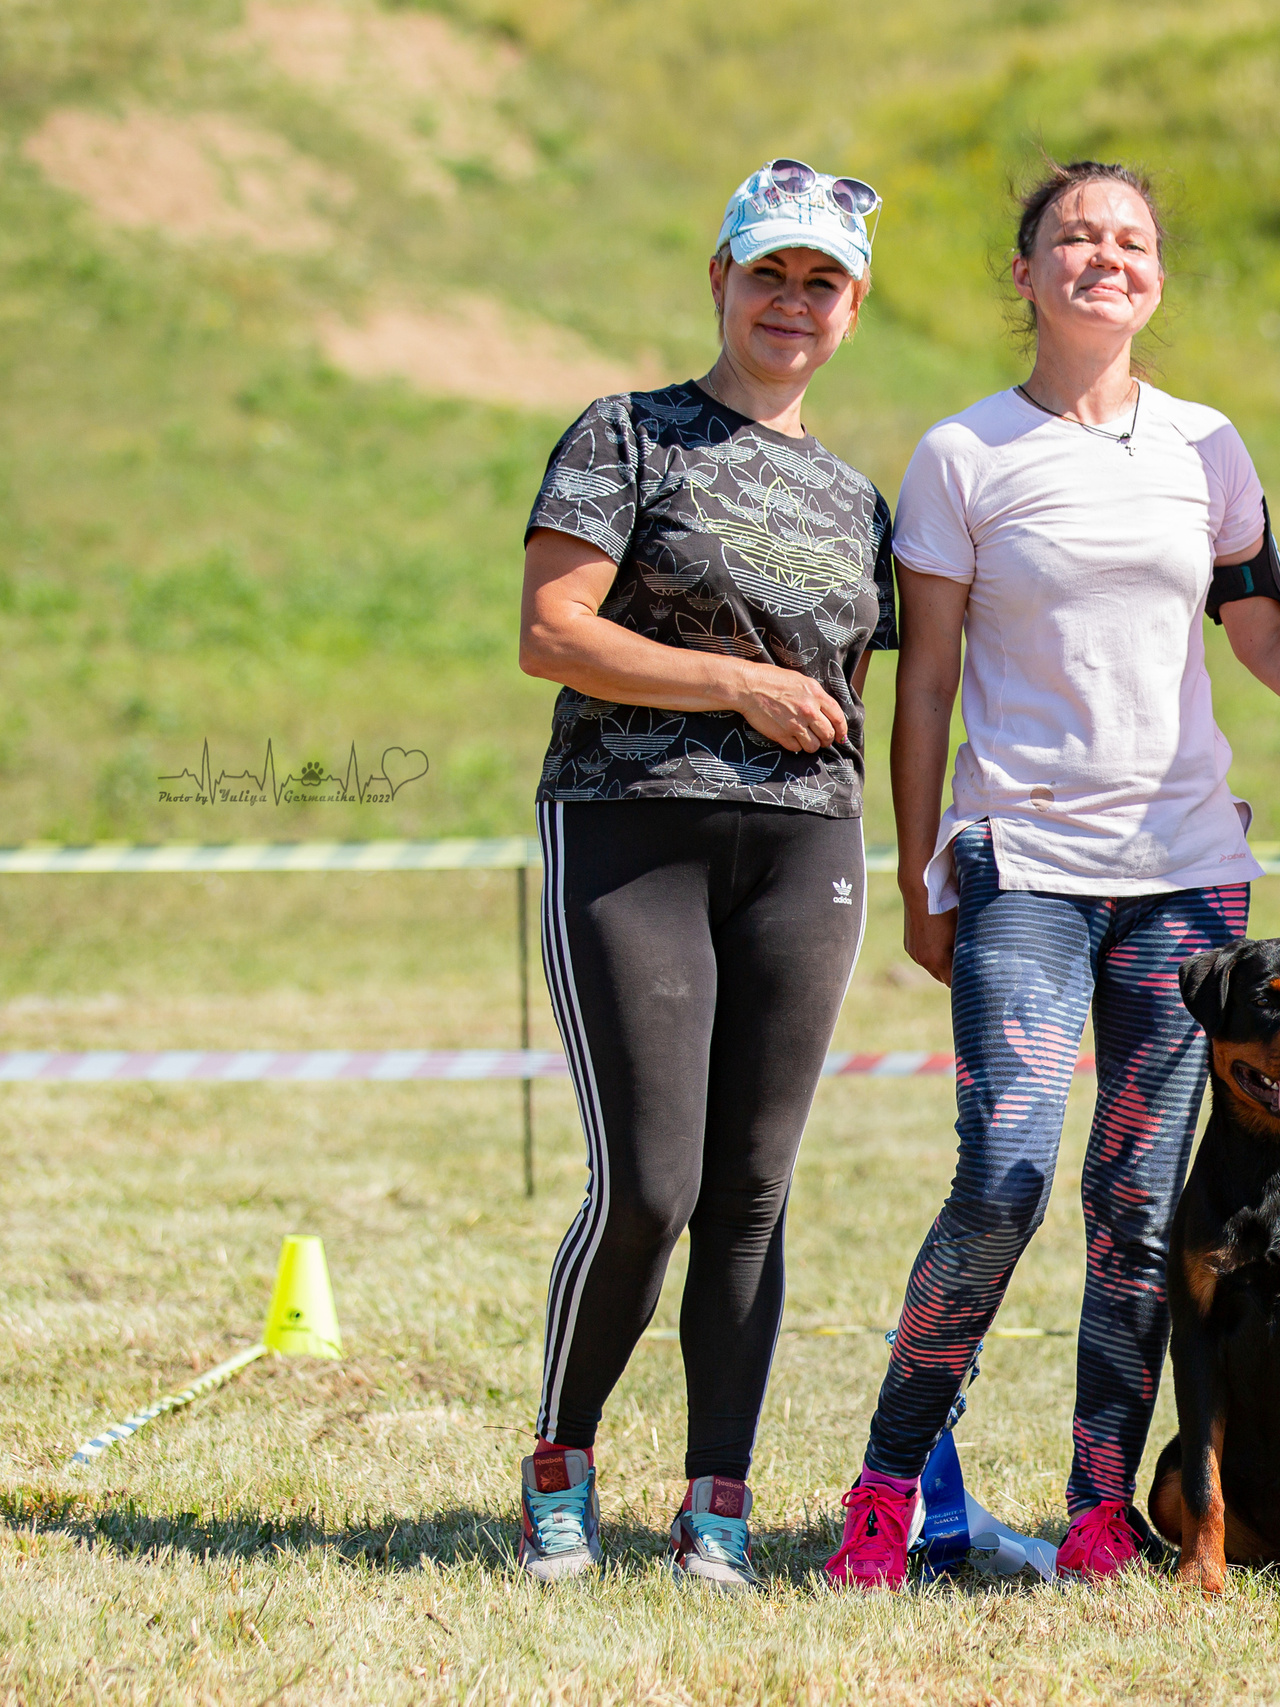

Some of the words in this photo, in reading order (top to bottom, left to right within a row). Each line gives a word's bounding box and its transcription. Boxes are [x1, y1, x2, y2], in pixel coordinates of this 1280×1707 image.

[833, 896, 853, 905] adidas
[535, 1457, 564, 1465] Reebok
[715, 1479, 743, 1490] Reebok
